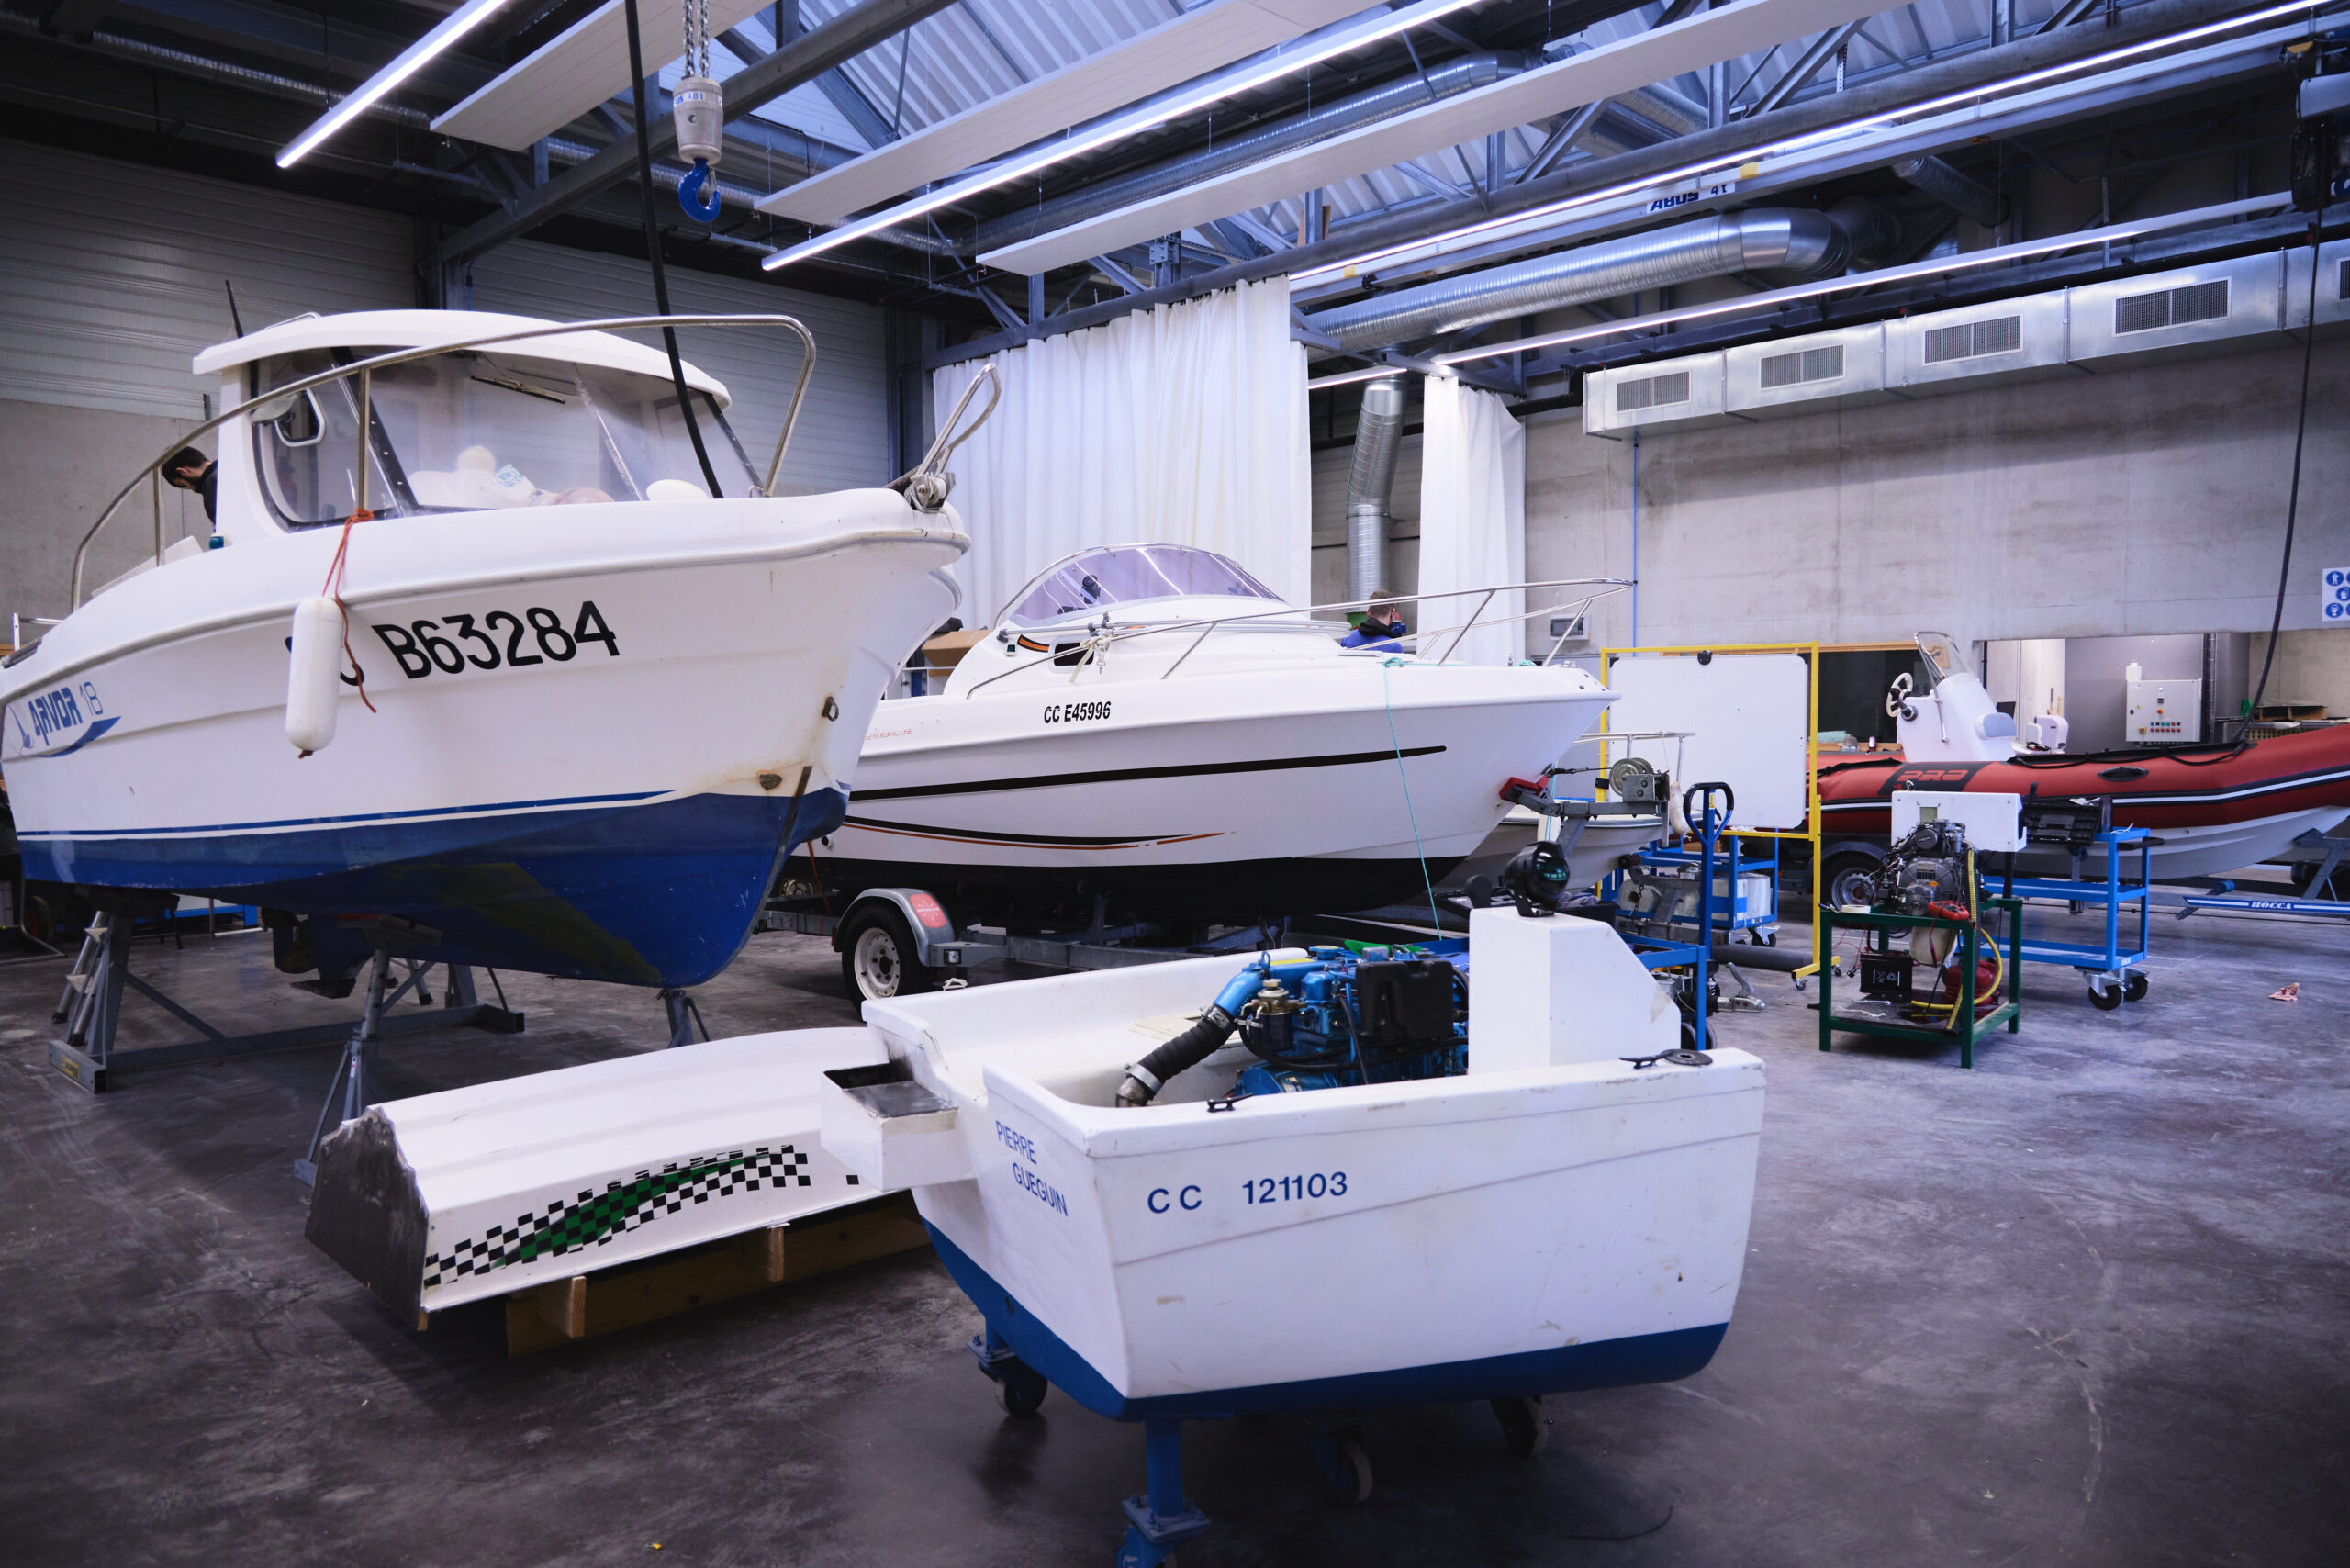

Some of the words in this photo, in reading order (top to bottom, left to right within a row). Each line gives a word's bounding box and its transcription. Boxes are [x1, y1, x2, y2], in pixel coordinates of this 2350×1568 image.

[1650, 191, 1700, 212] ABUS
[371, 600, 620, 679] B63284
[28, 687, 84, 746] ARVOR
[79, 681, 104, 716] 18
[1044, 705, 1060, 723] CC
[1064, 700, 1112, 722] E45996
[995, 1119, 1037, 1165] PIERRE
[1013, 1161, 1069, 1217] GUEGUIN
[1242, 1170, 1348, 1204] 121103
